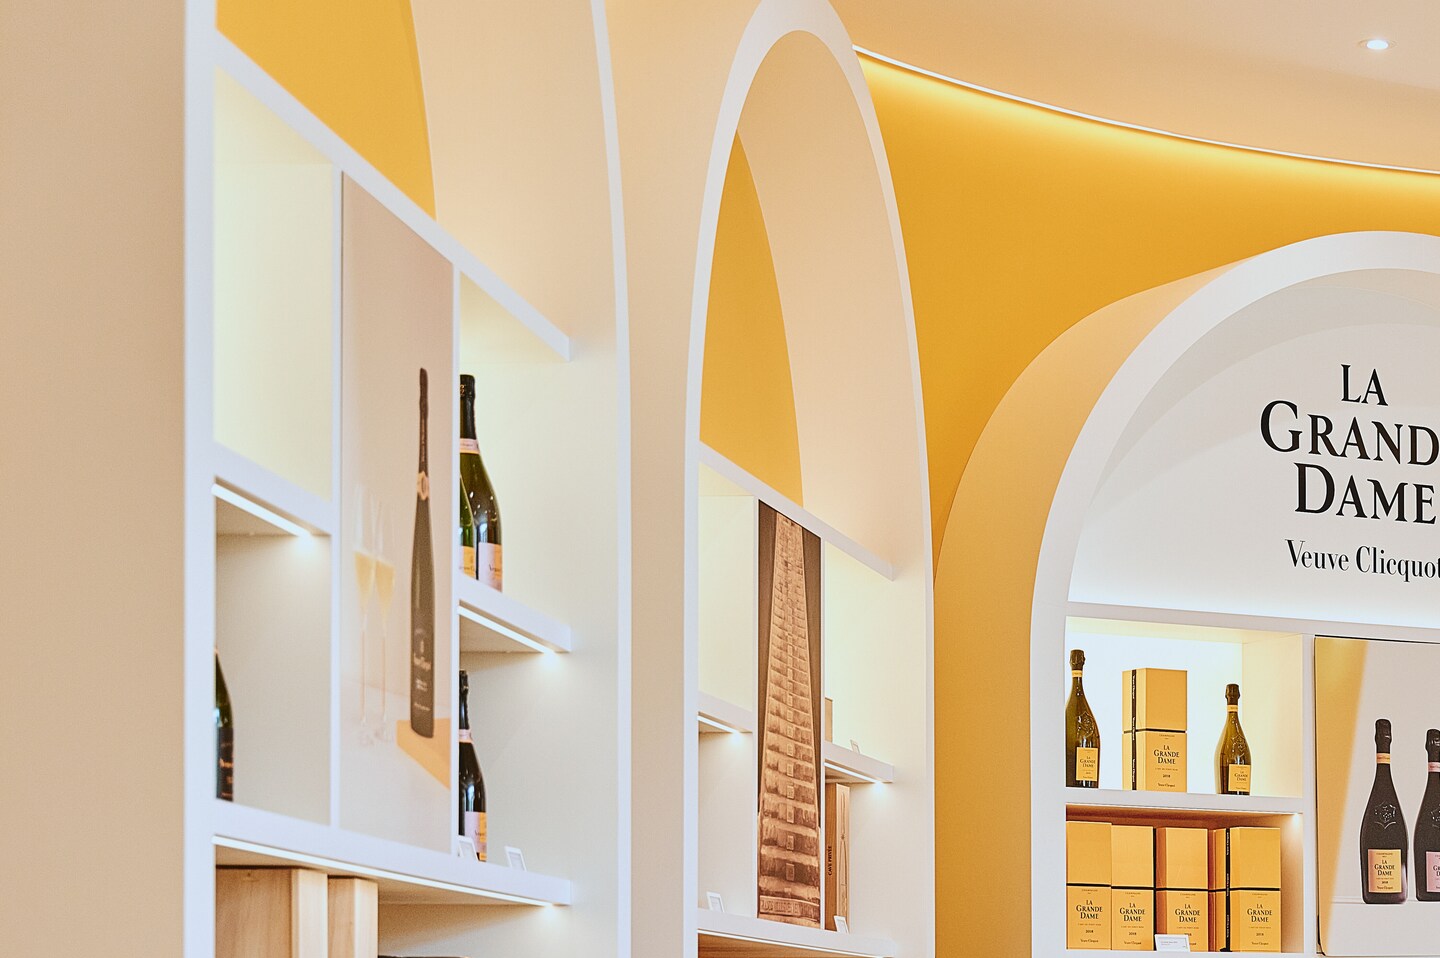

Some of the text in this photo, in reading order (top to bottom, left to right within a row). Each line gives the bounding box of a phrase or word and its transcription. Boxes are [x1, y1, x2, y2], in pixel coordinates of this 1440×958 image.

[1340, 363, 1389, 406] LA
[1293, 462, 1437, 525] DAME
[1285, 538, 1350, 572] Veuve
[1153, 749, 1180, 758] GRANDE
[1157, 756, 1176, 764] DAME
[1076, 904, 1103, 912] GRANDE
[1119, 907, 1145, 915] GRANDE
[1175, 908, 1201, 916] GRANDE
[1247, 908, 1272, 916] GRANDE
[1080, 911, 1099, 919] DAME
[1123, 914, 1142, 922] DAME
